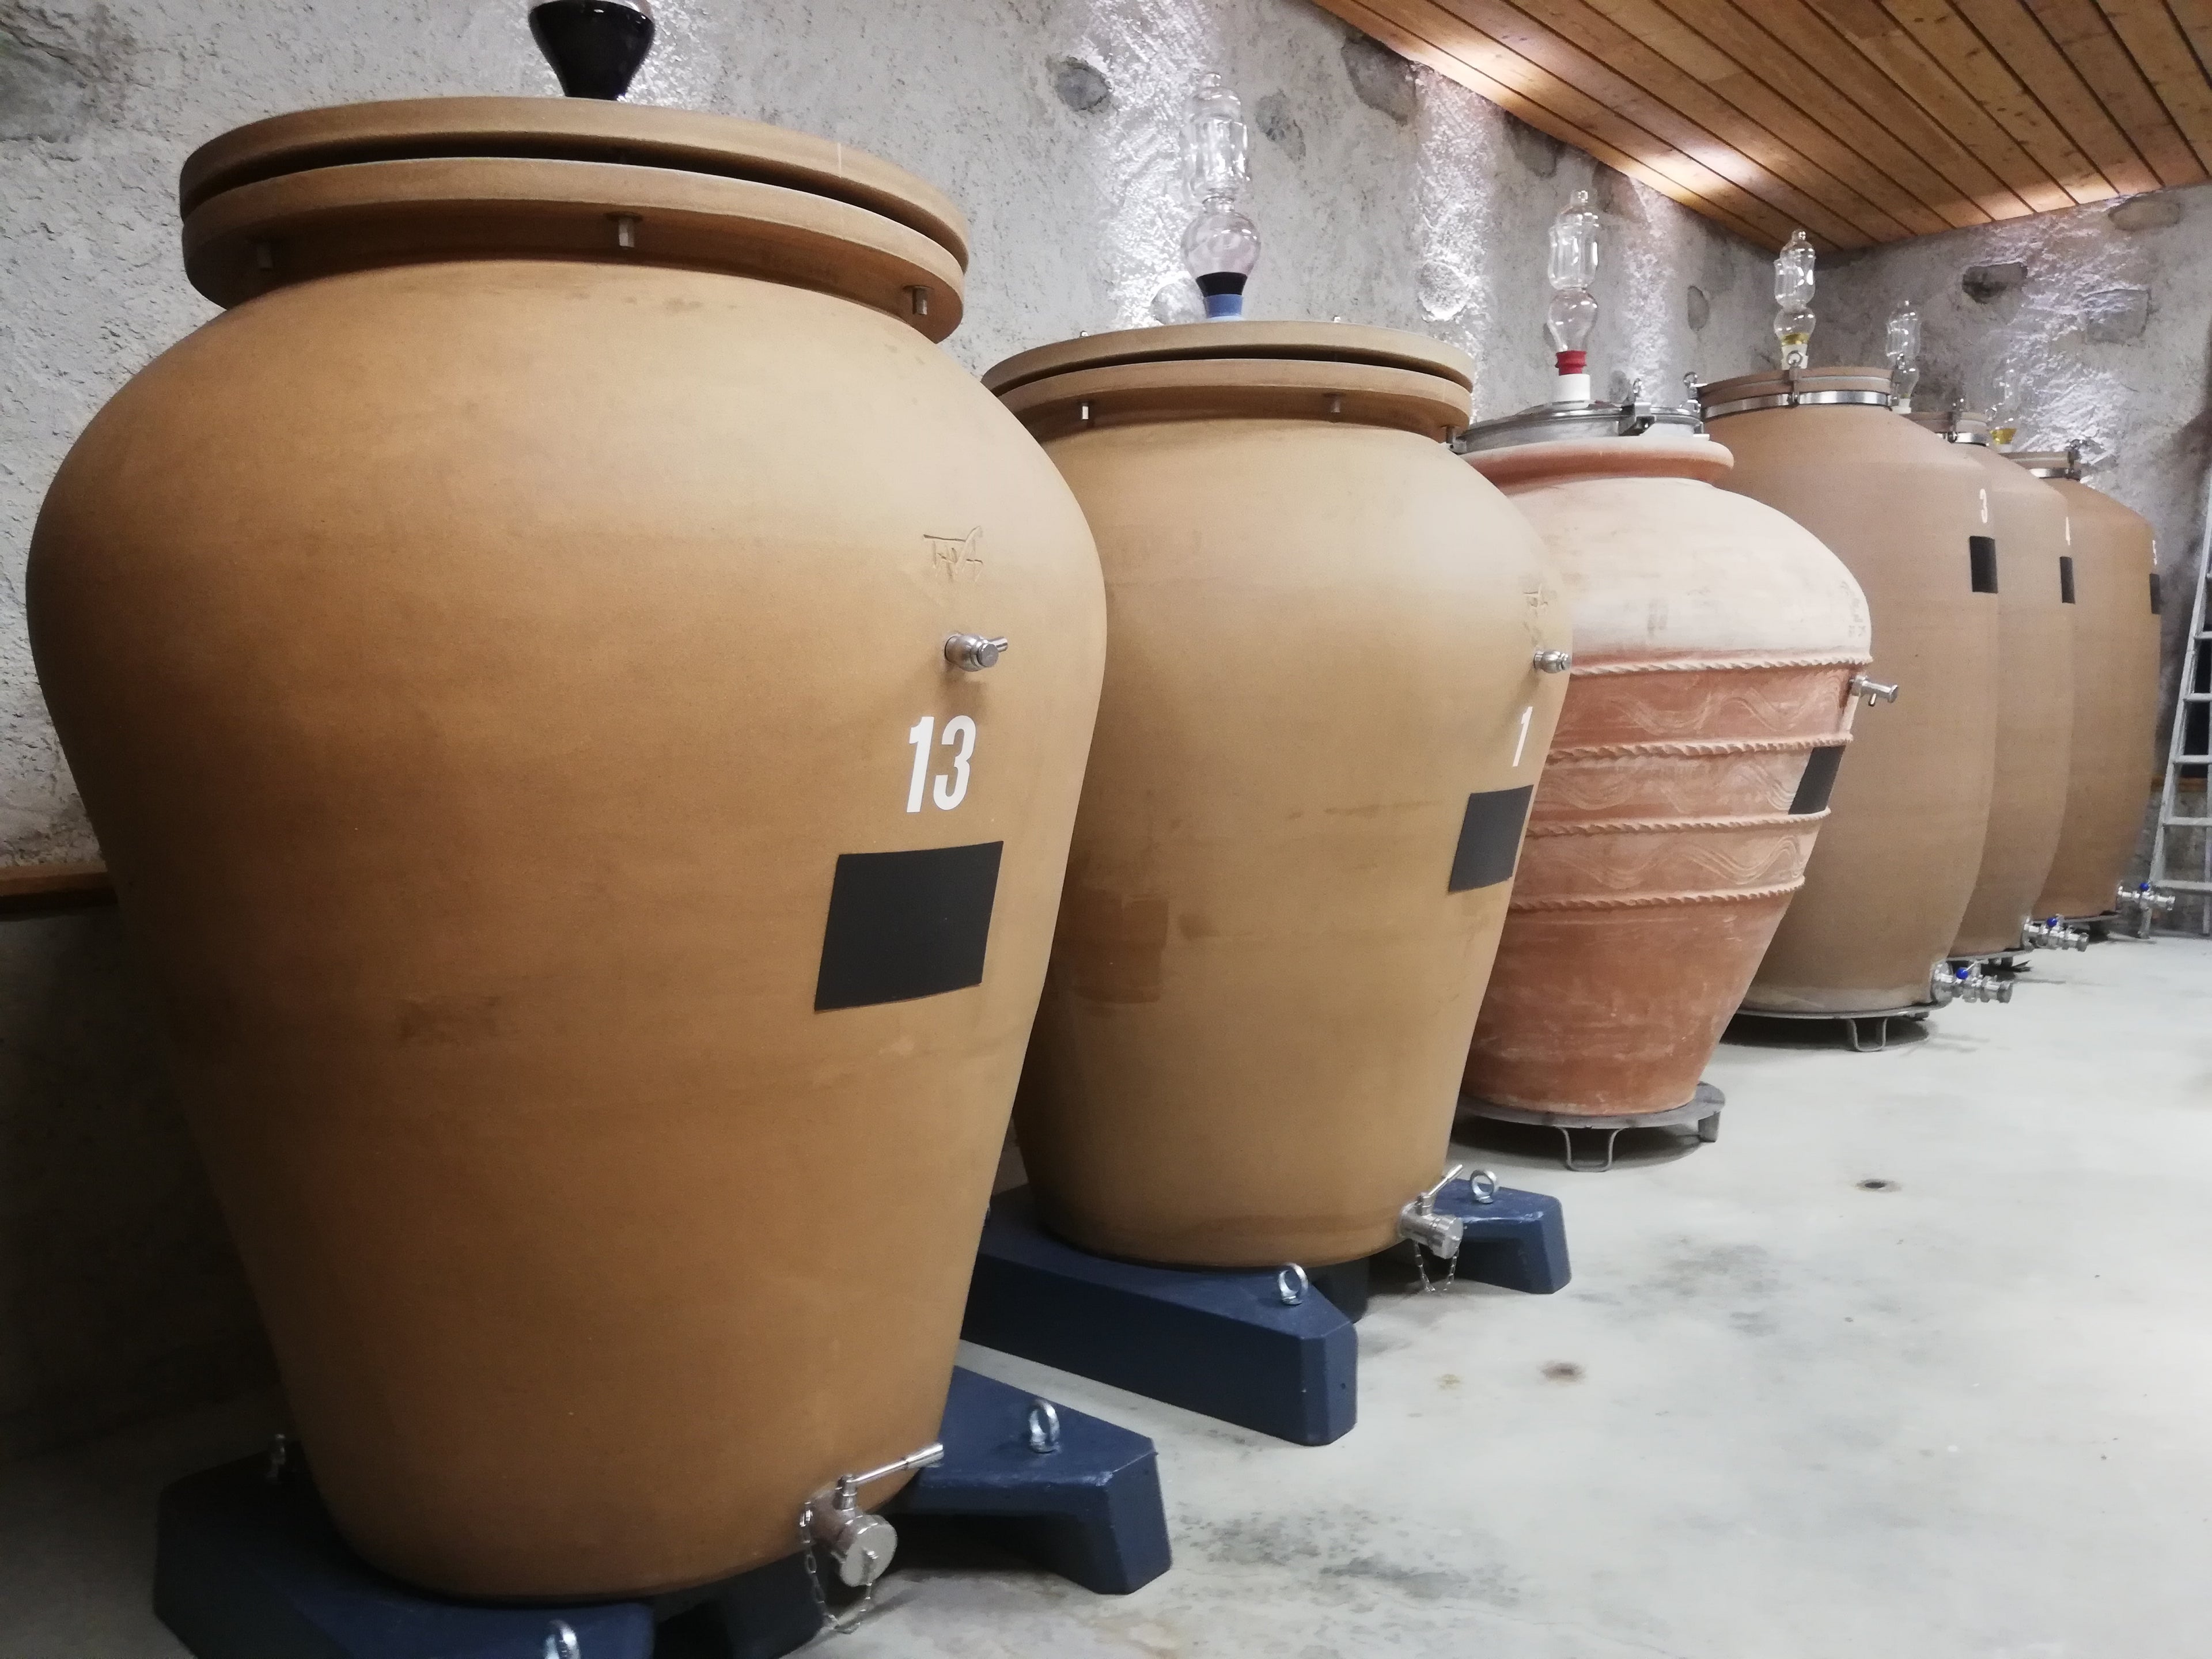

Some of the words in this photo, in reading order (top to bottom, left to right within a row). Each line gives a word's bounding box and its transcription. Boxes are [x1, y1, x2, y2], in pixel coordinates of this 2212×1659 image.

[1979, 488, 1988, 524] 3
[906, 715, 976, 813] 13
[1512, 706, 1533, 767] 1
